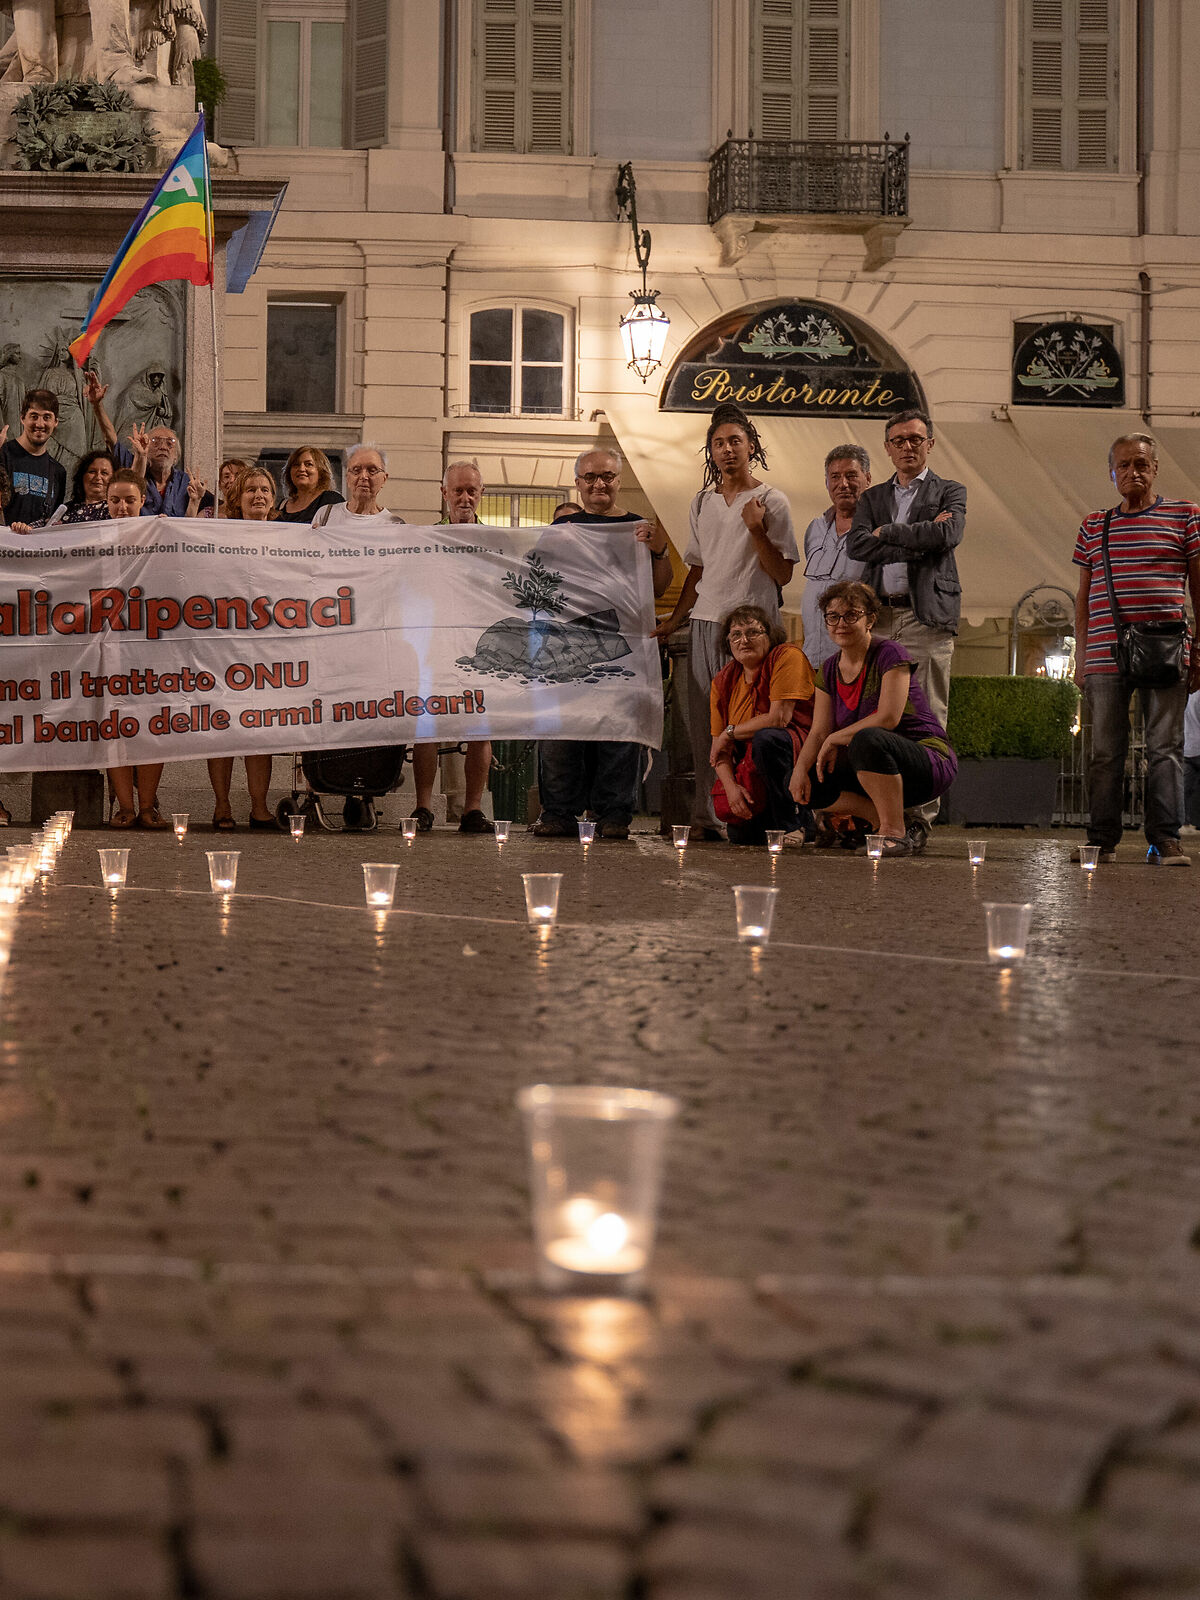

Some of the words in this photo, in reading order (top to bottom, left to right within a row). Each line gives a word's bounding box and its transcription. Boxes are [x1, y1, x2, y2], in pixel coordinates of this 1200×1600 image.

[691, 368, 904, 407] Ristorante
[70, 545, 95, 558] enti
[99, 544, 115, 557] ed
[181, 542, 215, 554] locali
[218, 545, 258, 556] contro
[261, 545, 325, 559] l'atomica,
[328, 547, 361, 558] tutte
[363, 545, 376, 557] le
[378, 544, 421, 557] guerre
[423, 545, 432, 554] e
[434, 544, 439, 553] i
[50, 670, 71, 700] il
[79, 666, 216, 698] trattato
[224, 660, 310, 692] ONU
[33, 710, 141, 744] bando
[148, 705, 232, 736] delle
[239, 698, 323, 729] armi
[332, 689, 487, 723] nucleari!
